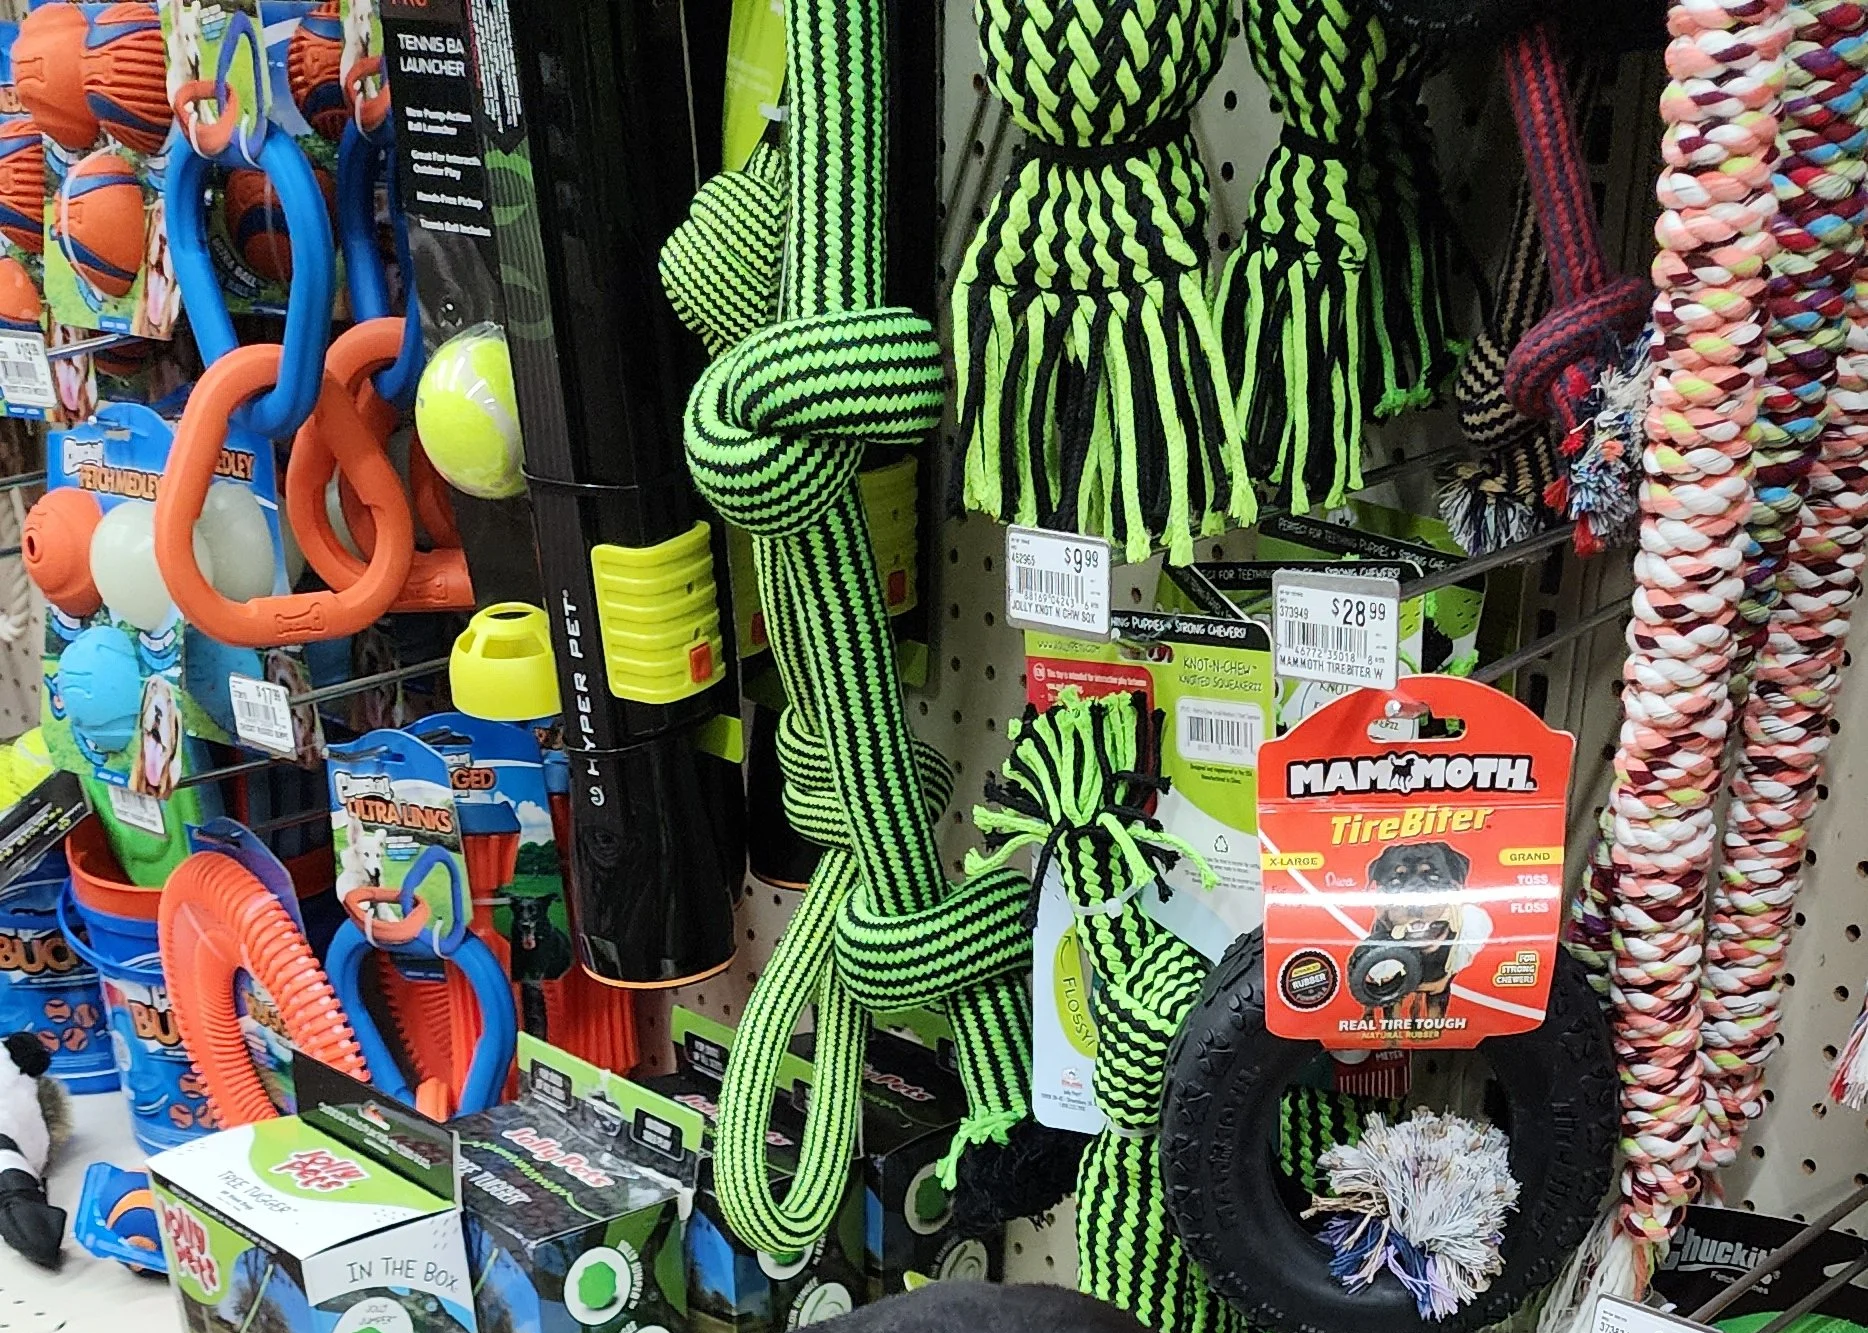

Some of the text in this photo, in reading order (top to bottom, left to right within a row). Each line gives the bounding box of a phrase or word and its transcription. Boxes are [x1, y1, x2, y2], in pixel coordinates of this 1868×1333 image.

[397, 33, 465, 54] TENNIS BA
[400, 56, 466, 77] LAUNCHER
[216, 449, 255, 481] EDLEY
[117, 470, 161, 500] MEDLE
[1012, 599, 1033, 613] JOLLY
[1035, 602, 1054, 616] KNOT
[1279, 604, 1309, 621] 373949
[1174, 620, 1206, 636] STRONG
[1207, 622, 1247, 639] CHEWERS!
[1279, 654, 1384, 681] MAMMOTH TIREBITER W
[573, 672, 601, 776] HYPER
[452, 767, 495, 790] GED
[1289, 756, 1530, 796] MAMMOTH
[348, 799, 454, 834] ULTRA LINKS
[1331, 805, 1493, 846] TireBiter
[1269, 857, 1319, 868] X-LARGE
[1509, 851, 1551, 863] GRAND
[1516, 873, 1549, 886] TOSS
[1510, 902, 1549, 914] FLOSS
[1291, 972, 1327, 990] RUBBER
[1062, 975, 1096, 1048] FLOSSY!
[1338, 1017, 1468, 1032] REAL TIRE TOUGH
[1361, 1030, 1440, 1040] NATURAL RUBBER
[346, 1256, 460, 1293] IN THE BOX
